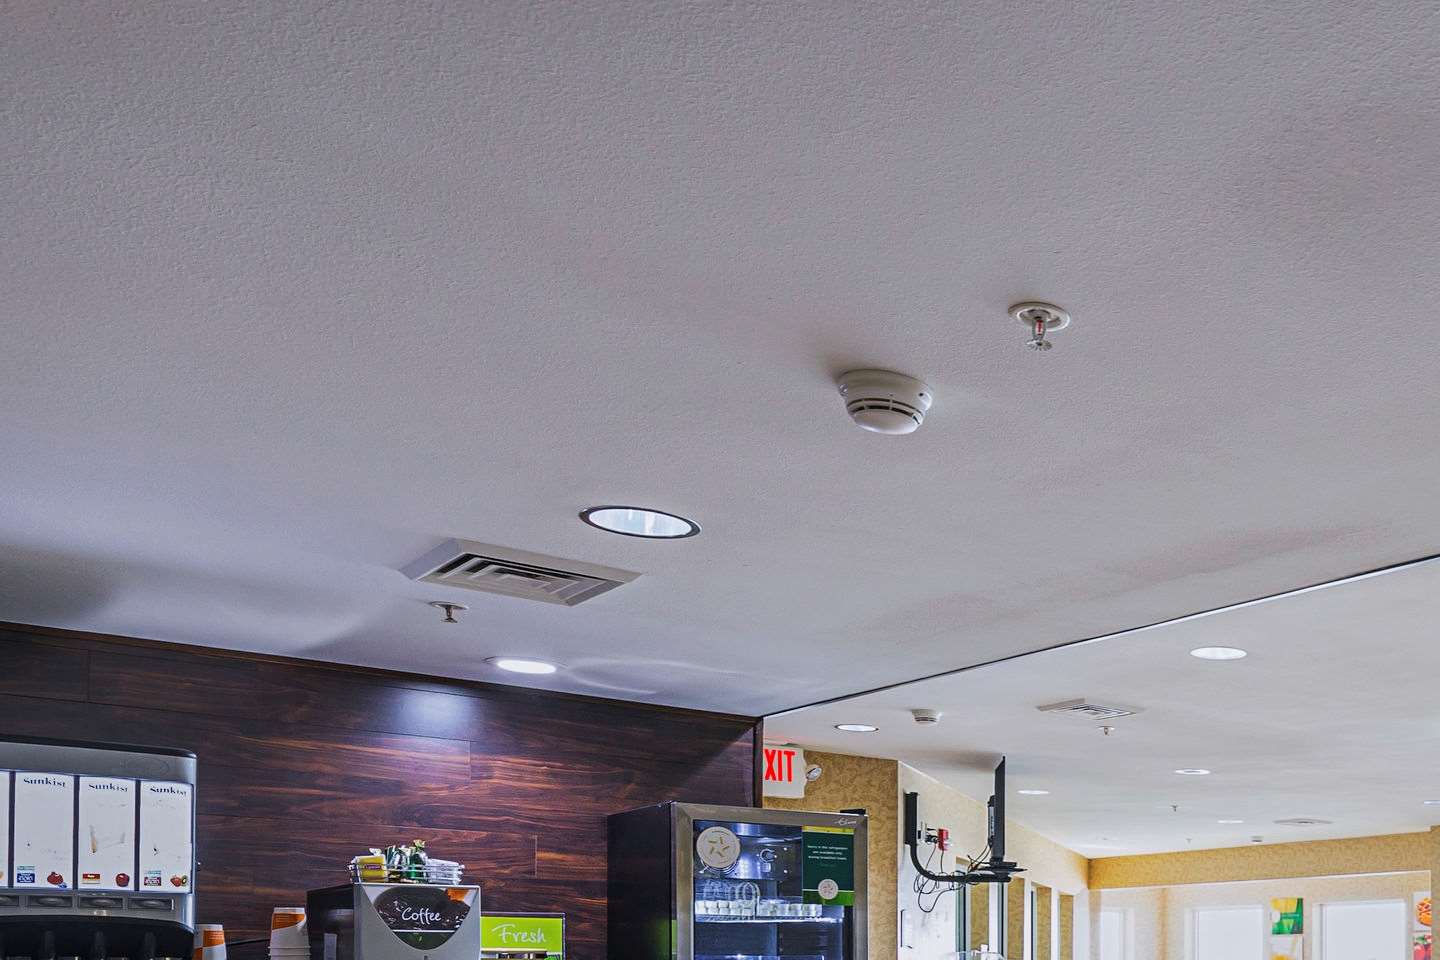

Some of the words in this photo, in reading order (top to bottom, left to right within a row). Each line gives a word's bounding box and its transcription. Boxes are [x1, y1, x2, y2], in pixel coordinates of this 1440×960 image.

[764, 748, 797, 782] XIT
[23, 777, 66, 788] Sunkist
[401, 907, 442, 925] Coffee
[491, 923, 547, 944] Fresh
